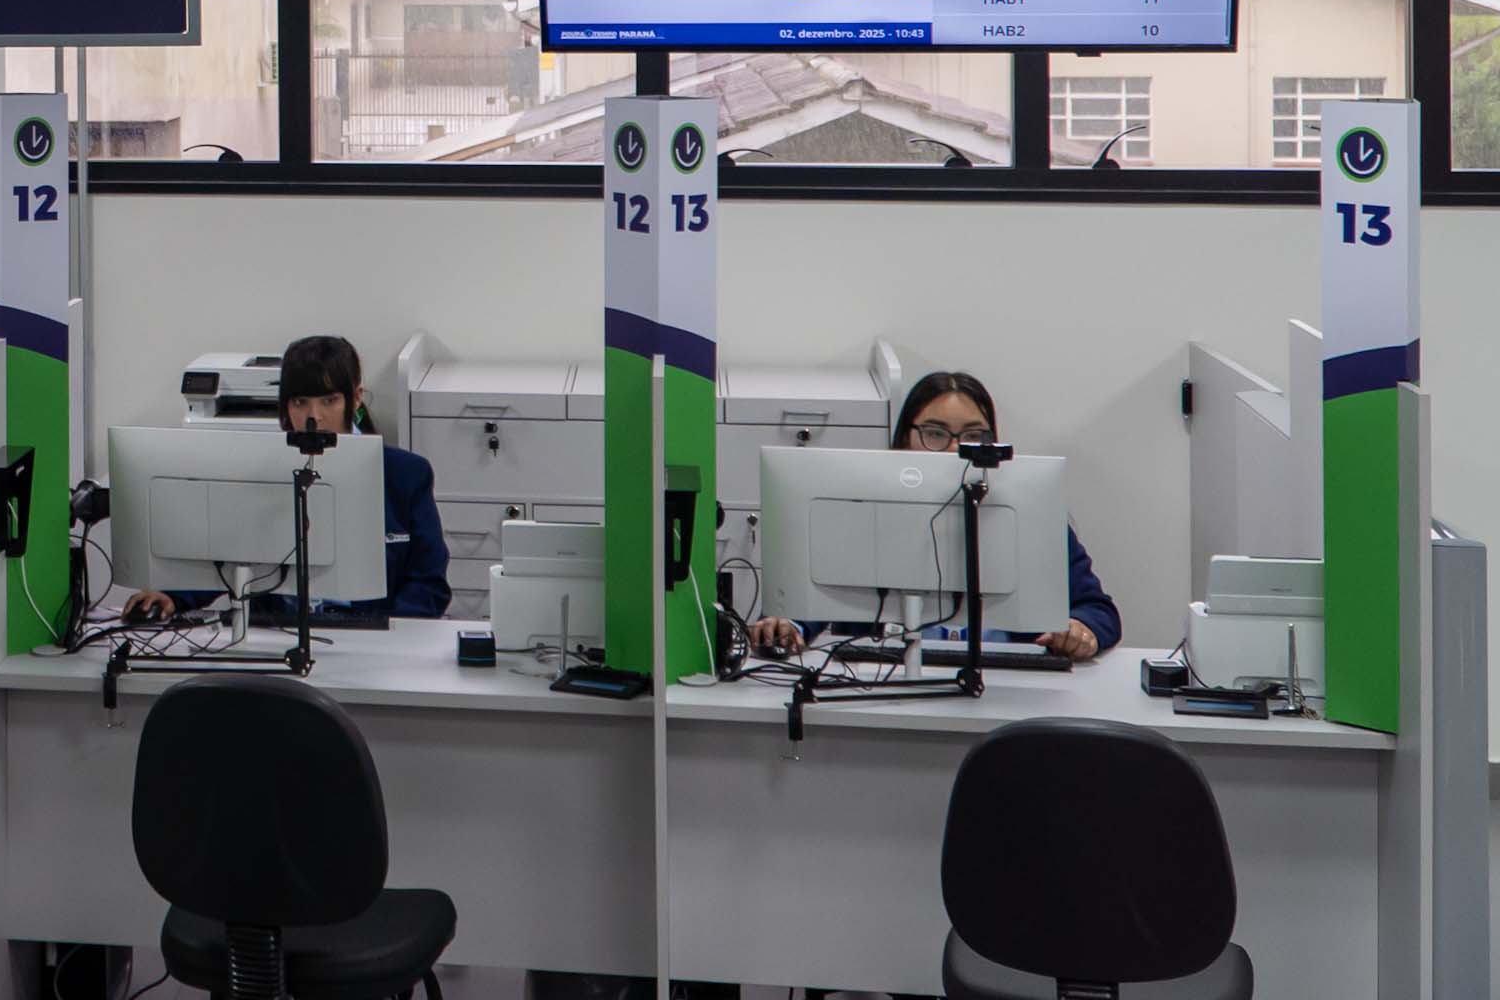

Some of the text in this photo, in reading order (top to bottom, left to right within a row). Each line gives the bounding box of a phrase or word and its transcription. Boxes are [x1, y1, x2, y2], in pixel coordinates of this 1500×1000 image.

[859, 29, 886, 38] 2025
[896, 29, 924, 38] 10:43
[983, 25, 1159, 37] HAB2 10
[13, 185, 58, 222] 12
[613, 192, 650, 233] 12
[671, 194, 709, 232] 13
[1336, 202, 1392, 246] 13
